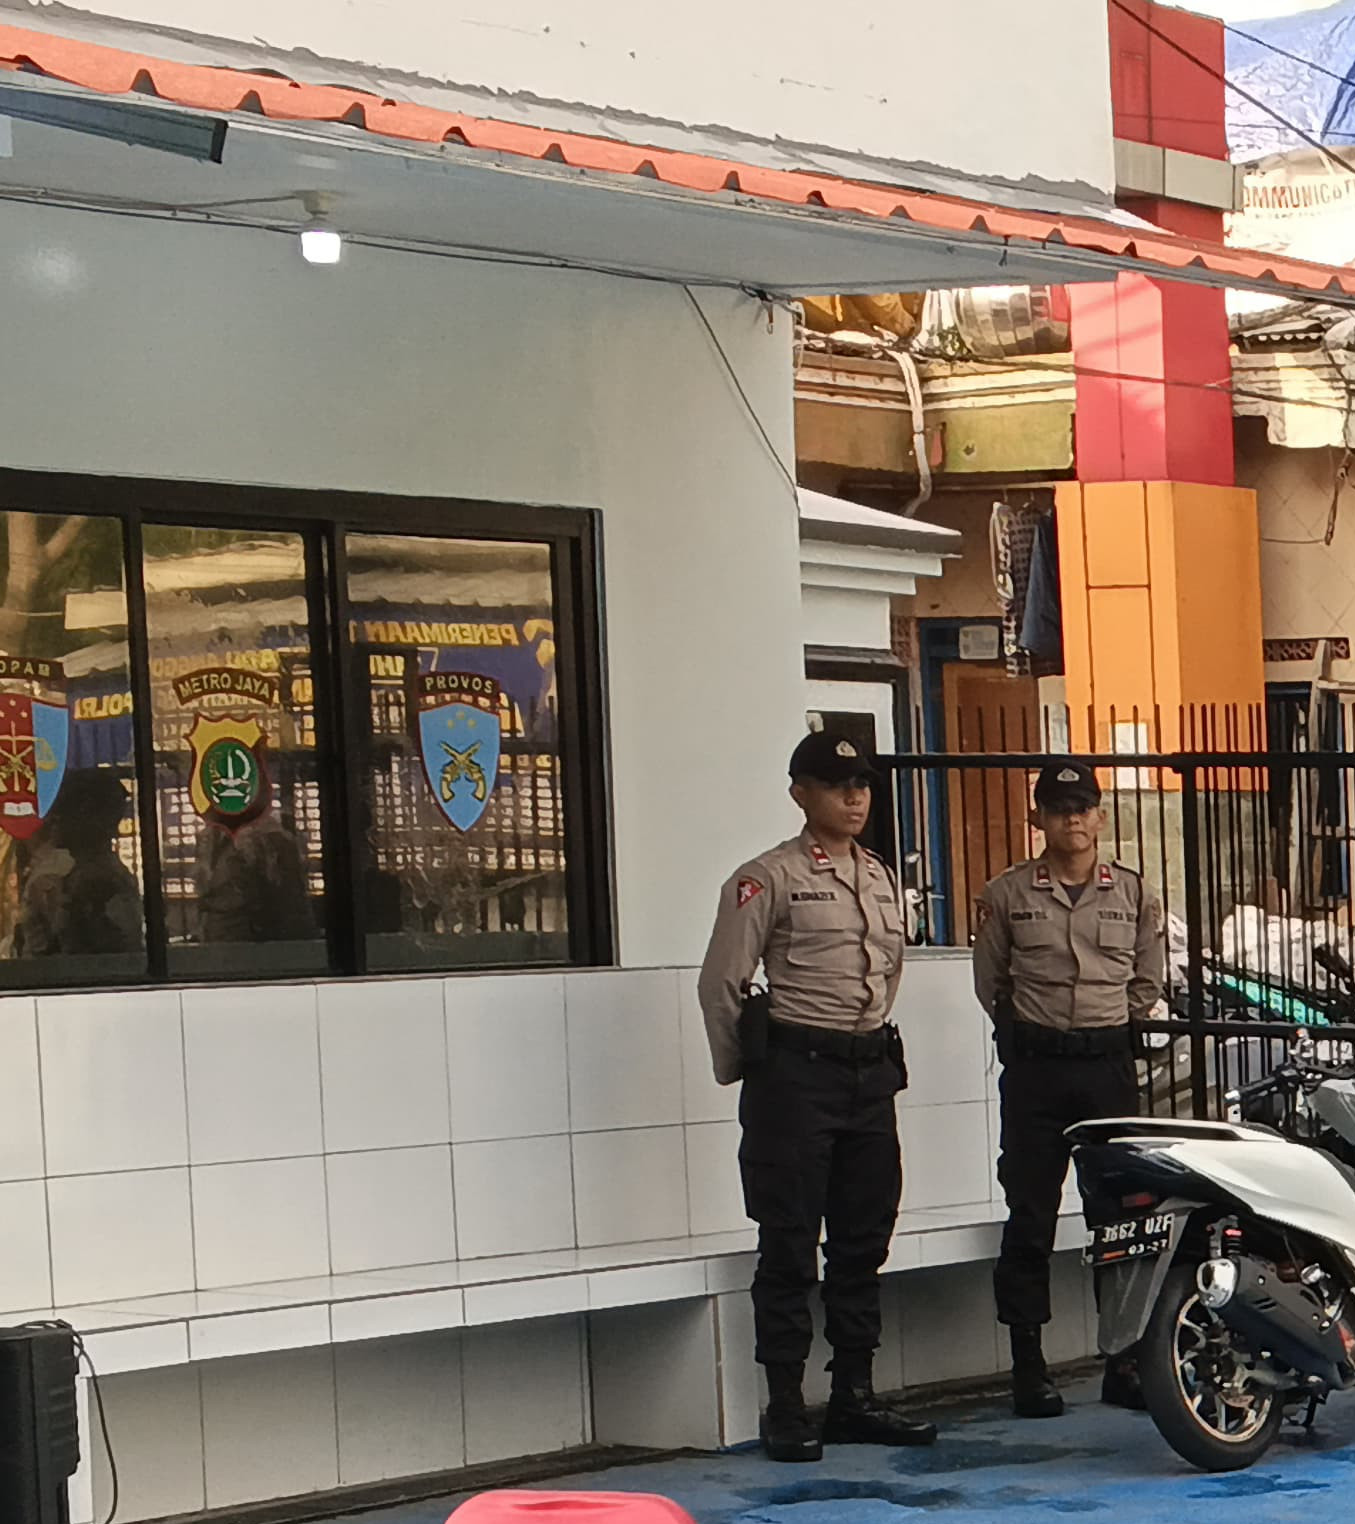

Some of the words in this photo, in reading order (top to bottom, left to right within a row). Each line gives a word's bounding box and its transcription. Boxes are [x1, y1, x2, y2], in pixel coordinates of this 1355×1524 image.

[178, 672, 231, 698] METRO
[235, 675, 270, 699] JAYA
[425, 675, 494, 694] PROVOS
